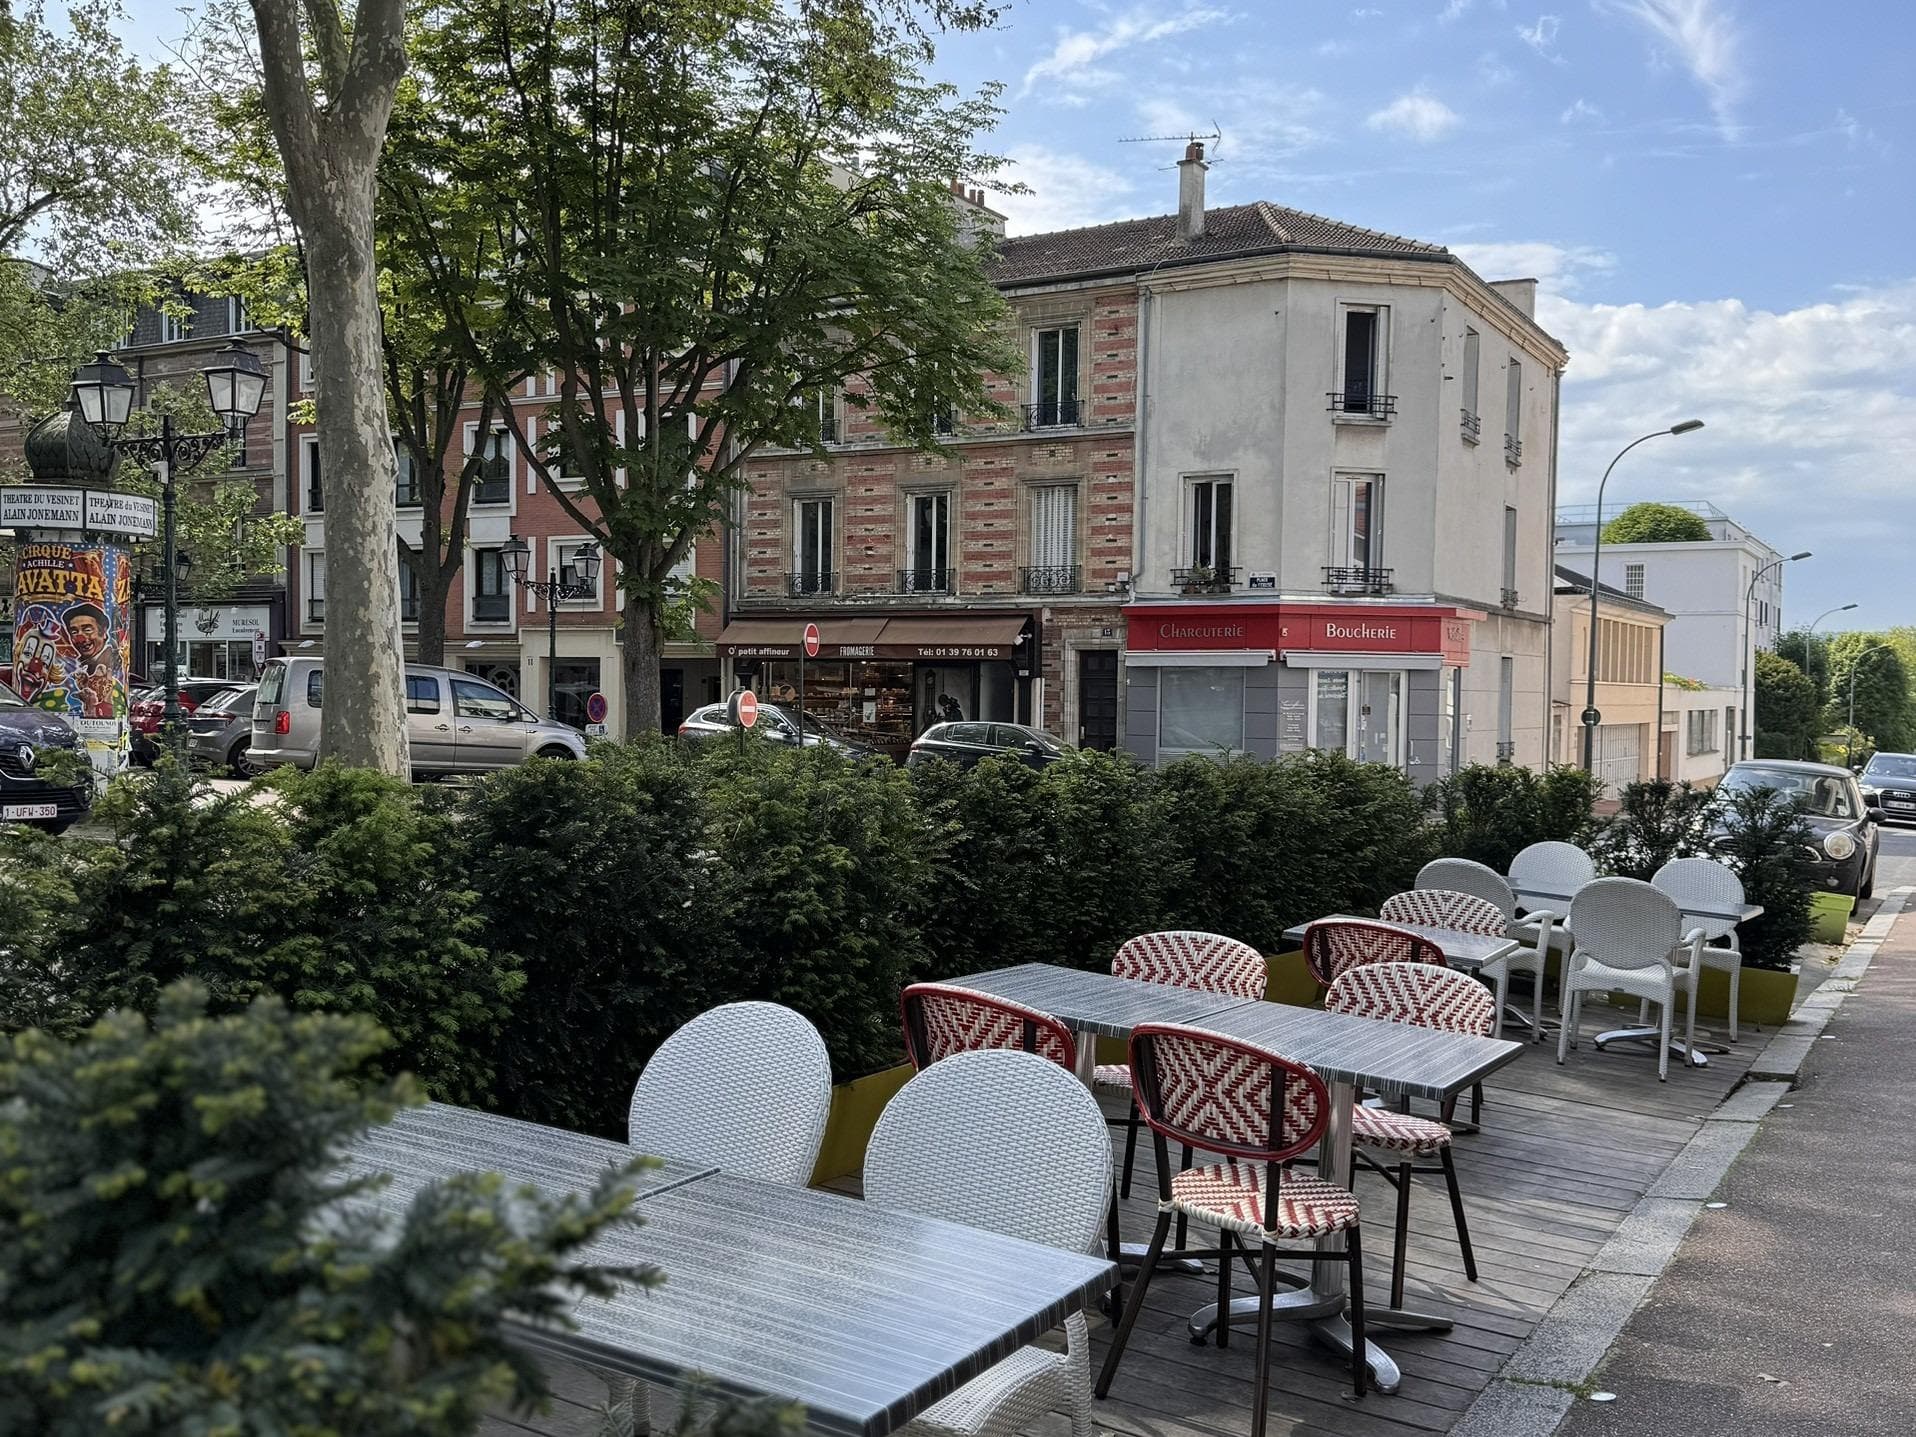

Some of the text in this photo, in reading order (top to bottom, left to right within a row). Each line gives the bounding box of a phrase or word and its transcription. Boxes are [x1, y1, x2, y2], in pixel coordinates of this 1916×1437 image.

[3, 494, 80, 506] THEATRE DU VESINET
[3, 508, 80, 522] ALAIN JONEMANN
[89, 512, 117, 525] ALAIN
[22, 545, 72, 560] CIRQUE
[26, 559, 66, 570] ACHILLE
[738, 647, 757, 656] petit
[758, 647, 790, 656] affineur
[839, 646, 875, 657] FROMAGERIE
[918, 648, 999, 656] Tél: 01 39 76 01 63
[5, 806, 56, 817] 1-UFW-350
